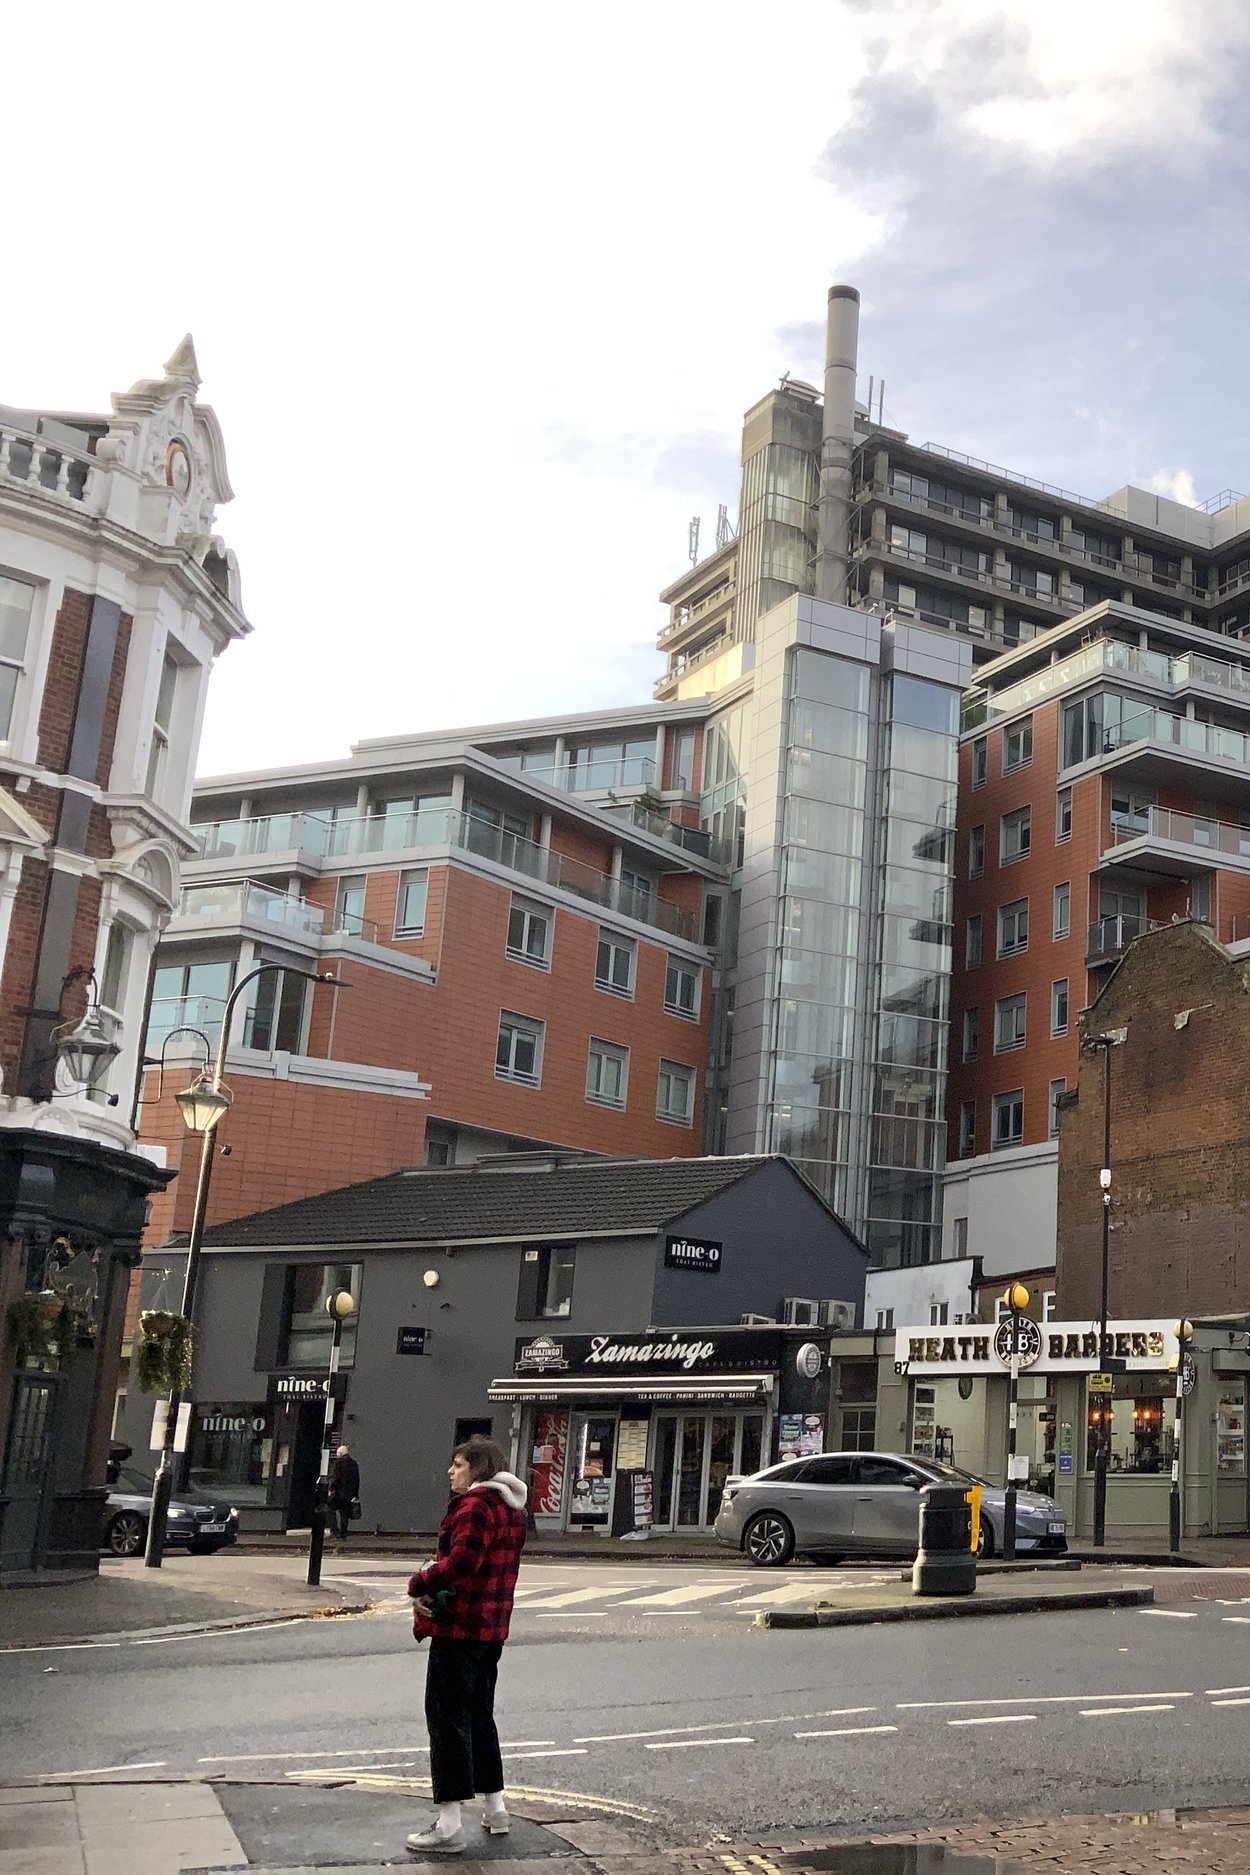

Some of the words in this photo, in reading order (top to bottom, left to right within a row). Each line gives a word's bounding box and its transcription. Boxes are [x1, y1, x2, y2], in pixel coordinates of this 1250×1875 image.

[672, 1240, 720, 1261] nine-o
[525, 1348, 560, 1357] ZAMAZINGO
[585, 1334, 714, 1369] Zamazingo
[908, 1336, 990, 1362] HEATH
[1048, 1332, 1165, 1359] BARBERS
[894, 1362, 910, 1375] 87
[202, 1413, 266, 1431] nine-o
